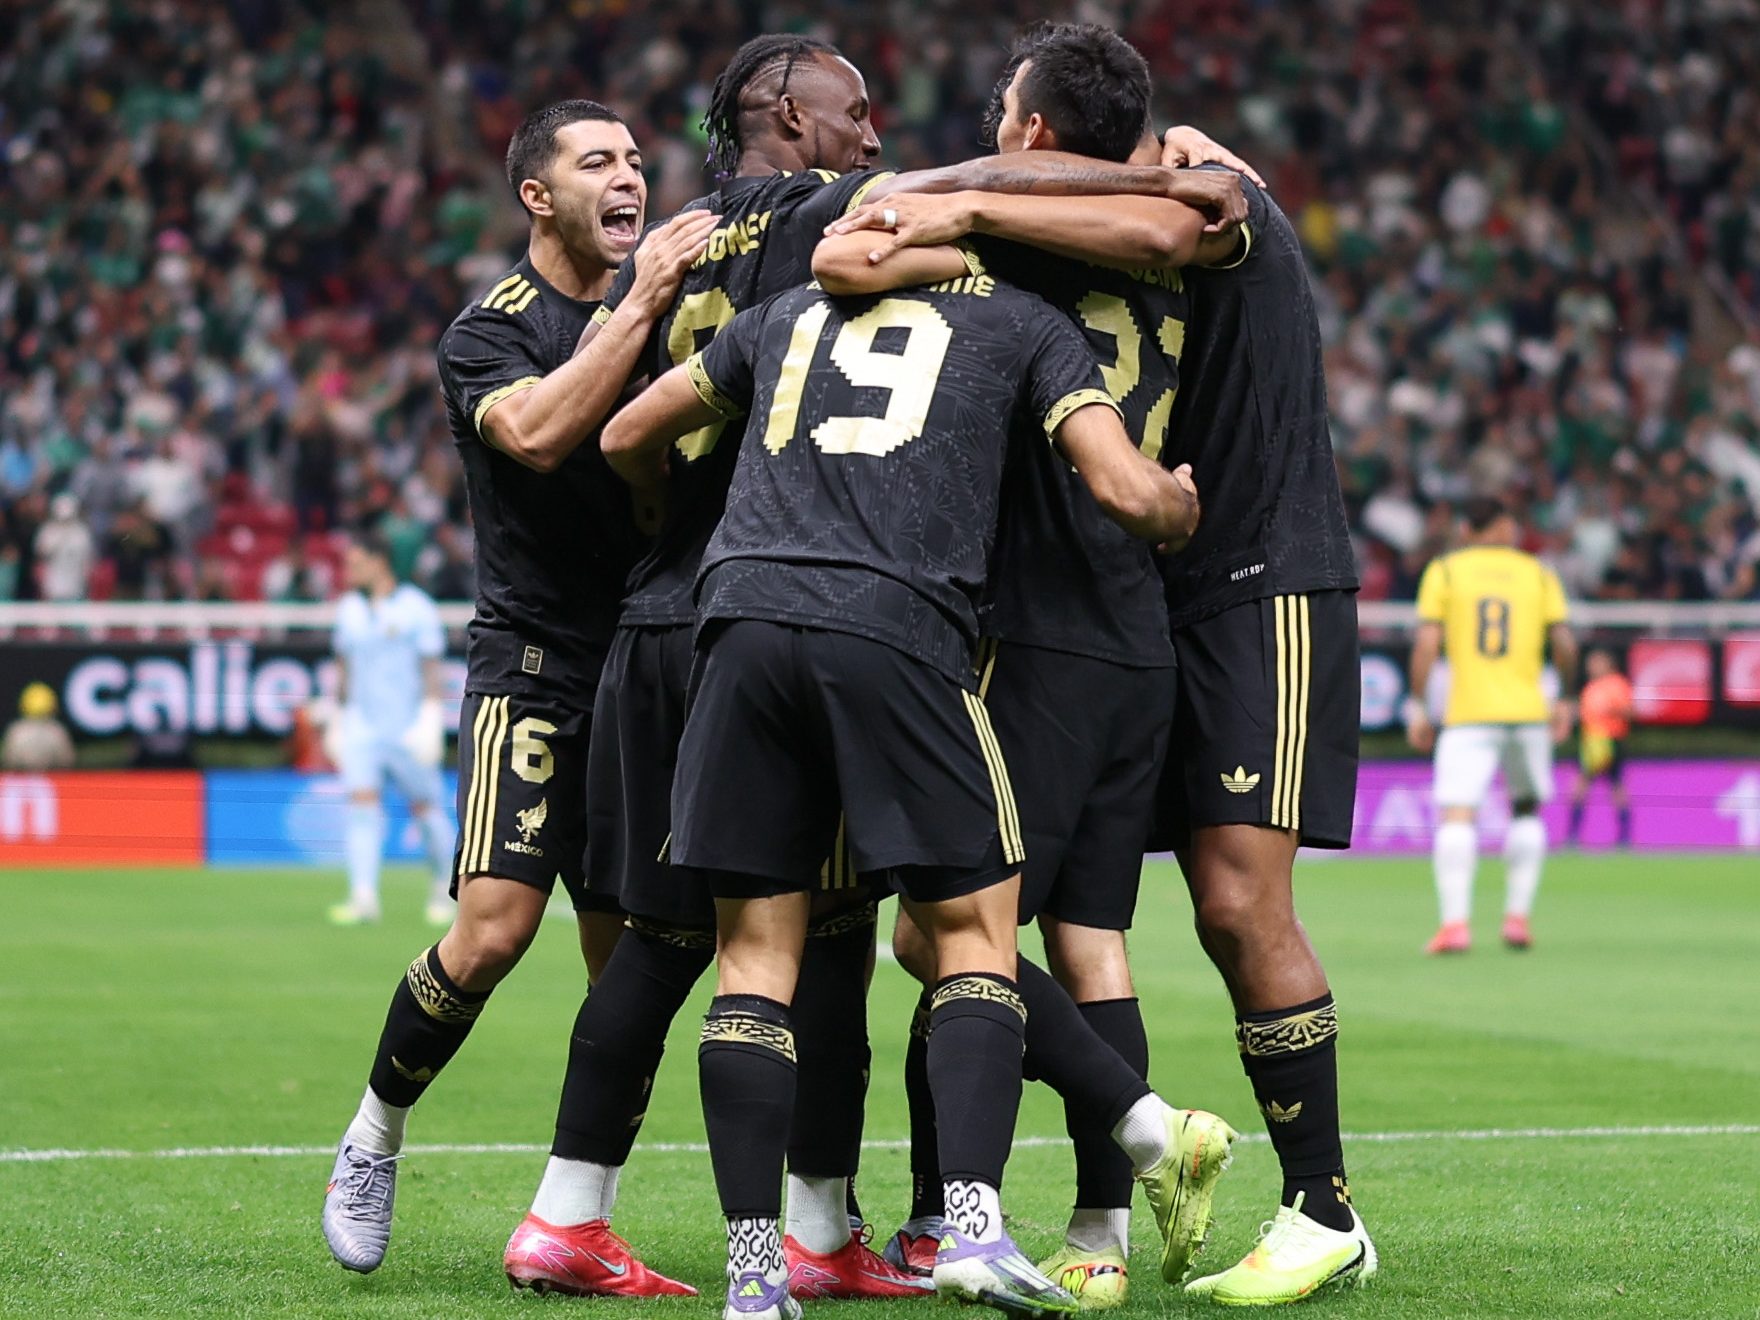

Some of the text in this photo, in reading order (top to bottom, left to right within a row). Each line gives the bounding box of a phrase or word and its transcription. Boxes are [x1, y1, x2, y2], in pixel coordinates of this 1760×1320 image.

[763, 298, 953, 457] 19
[1477, 597, 1509, 657] 8
[511, 717, 557, 784] 6
